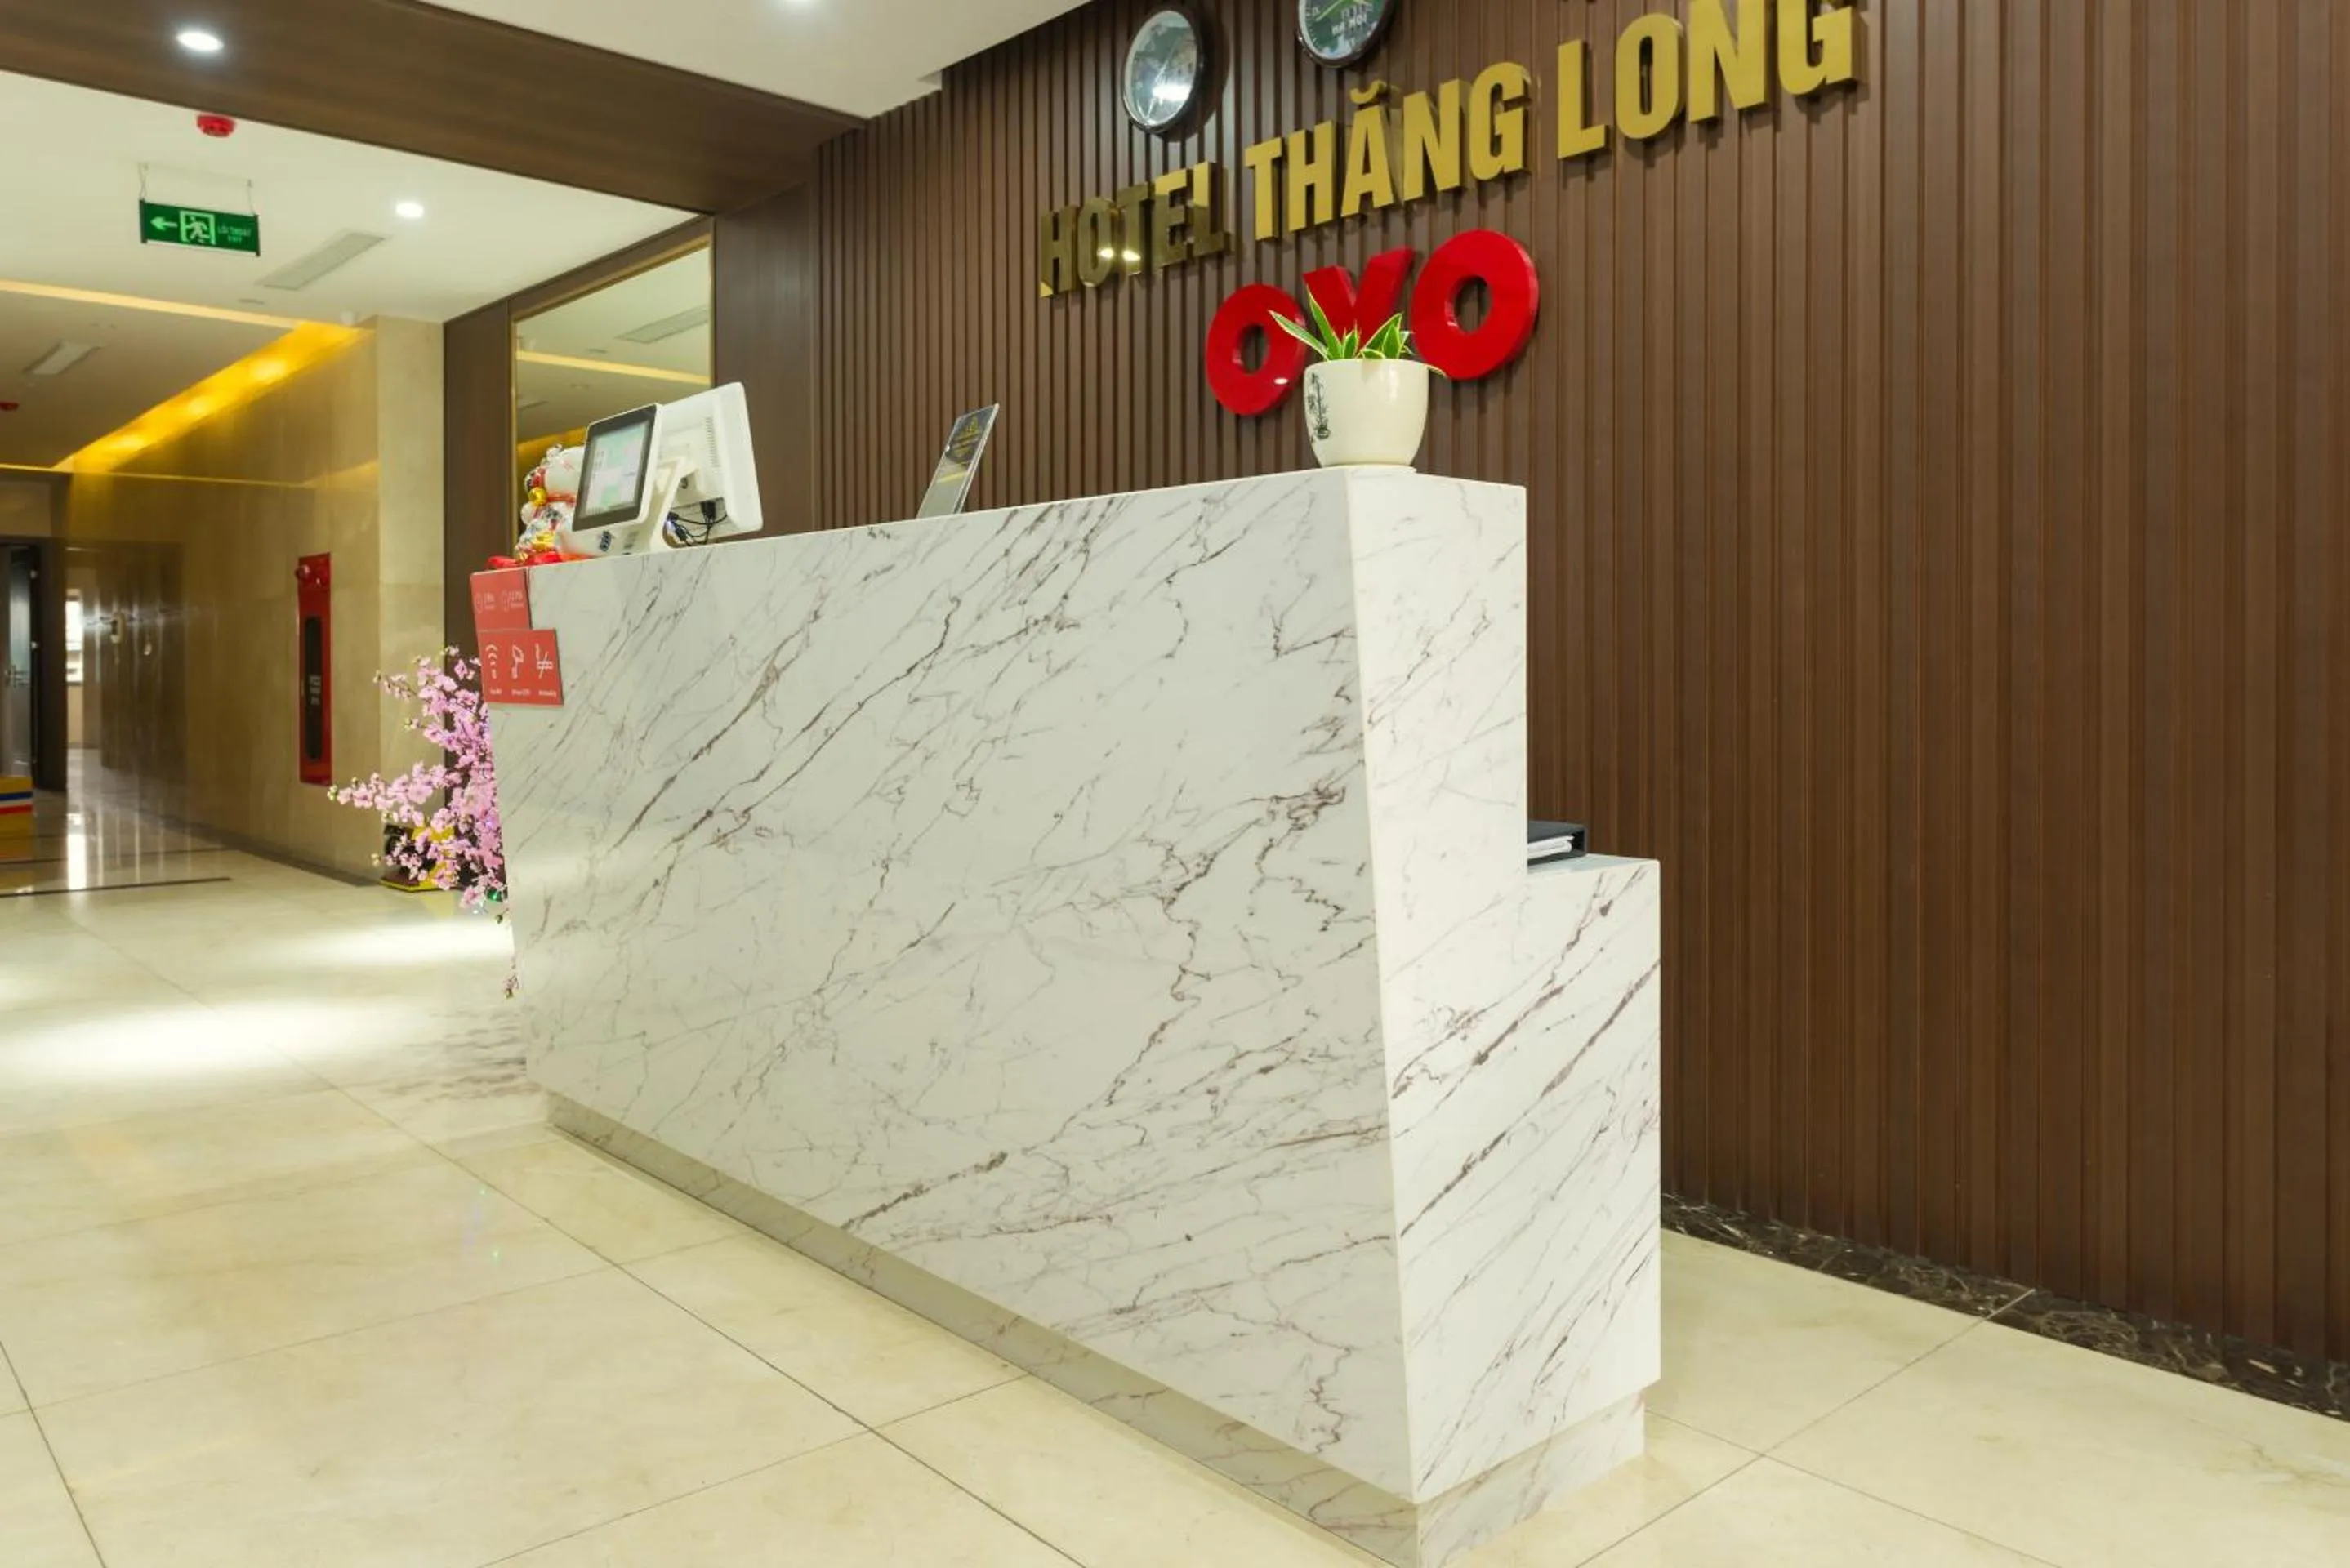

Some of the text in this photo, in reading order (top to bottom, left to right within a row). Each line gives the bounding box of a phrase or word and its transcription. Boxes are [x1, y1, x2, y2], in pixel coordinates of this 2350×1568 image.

[1040, 0, 1857, 298] HOTEL THĂNG LONG
[1205, 229, 1539, 416] OYO
